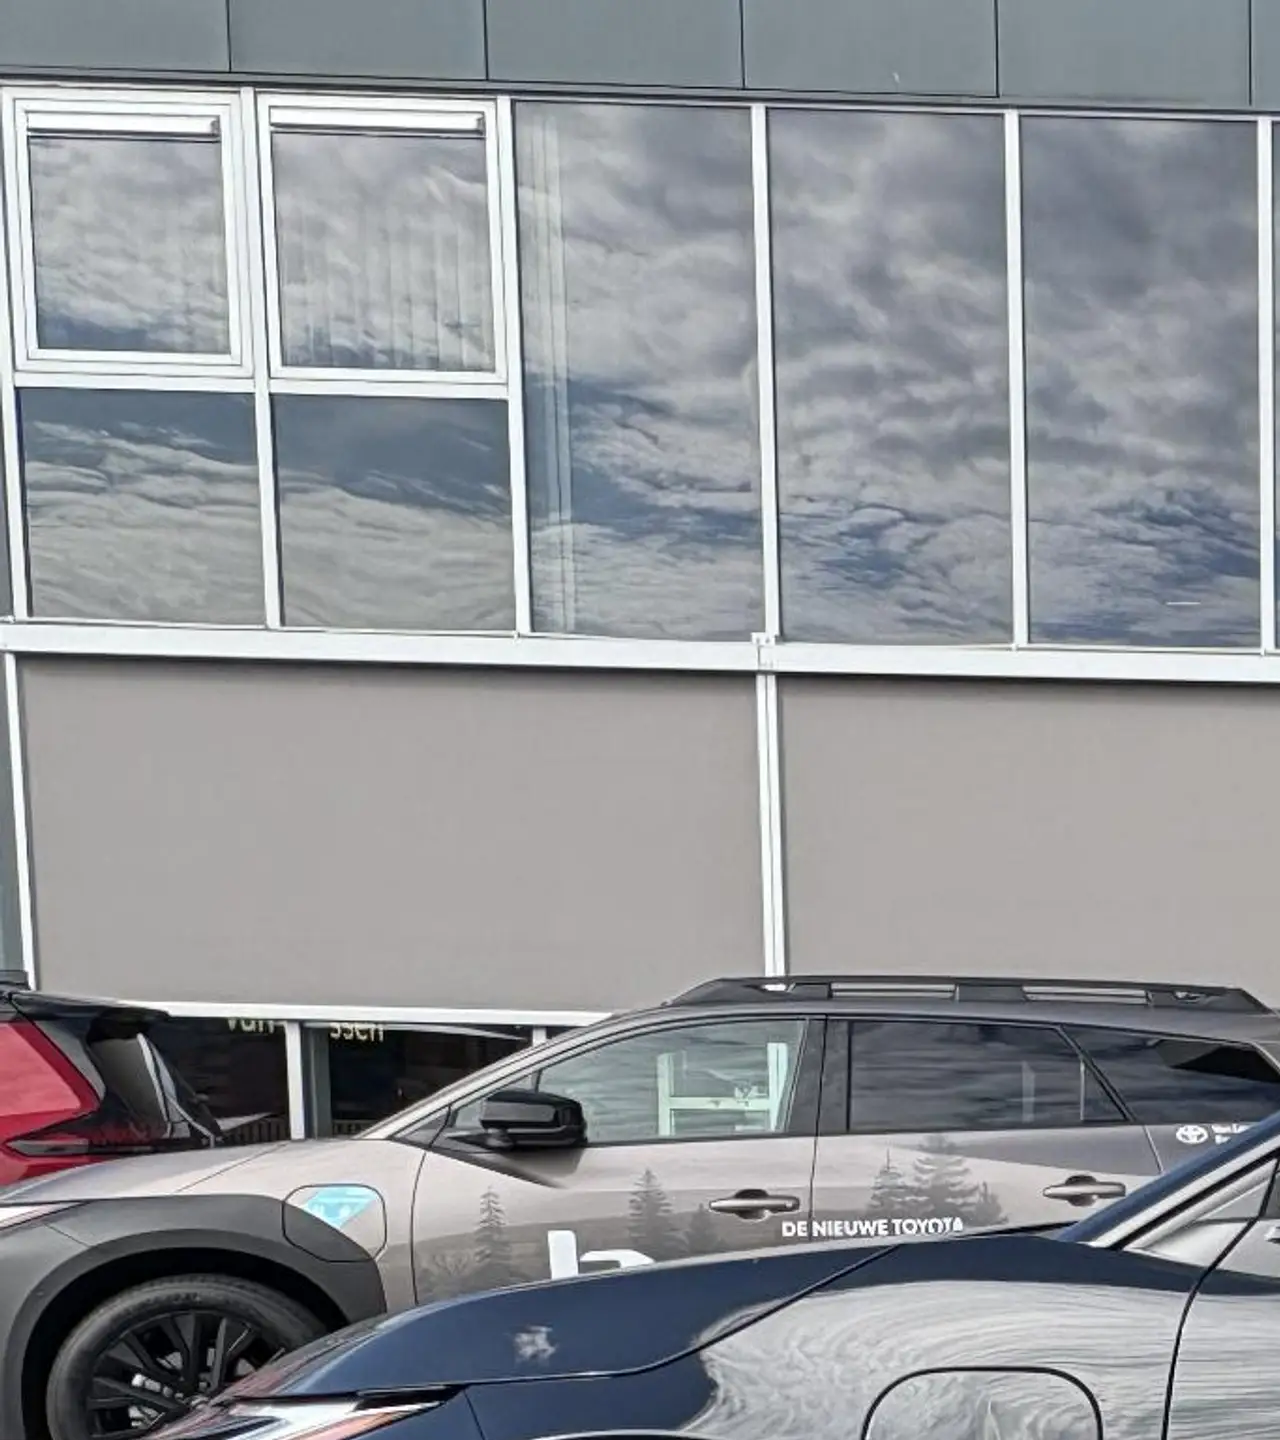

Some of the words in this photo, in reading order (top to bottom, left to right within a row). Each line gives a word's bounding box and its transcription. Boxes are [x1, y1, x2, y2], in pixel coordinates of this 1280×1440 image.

[781, 1220, 808, 1238] DE
[811, 1219, 889, 1237] NIEUWE
[891, 1216, 965, 1236] TOYOTA
